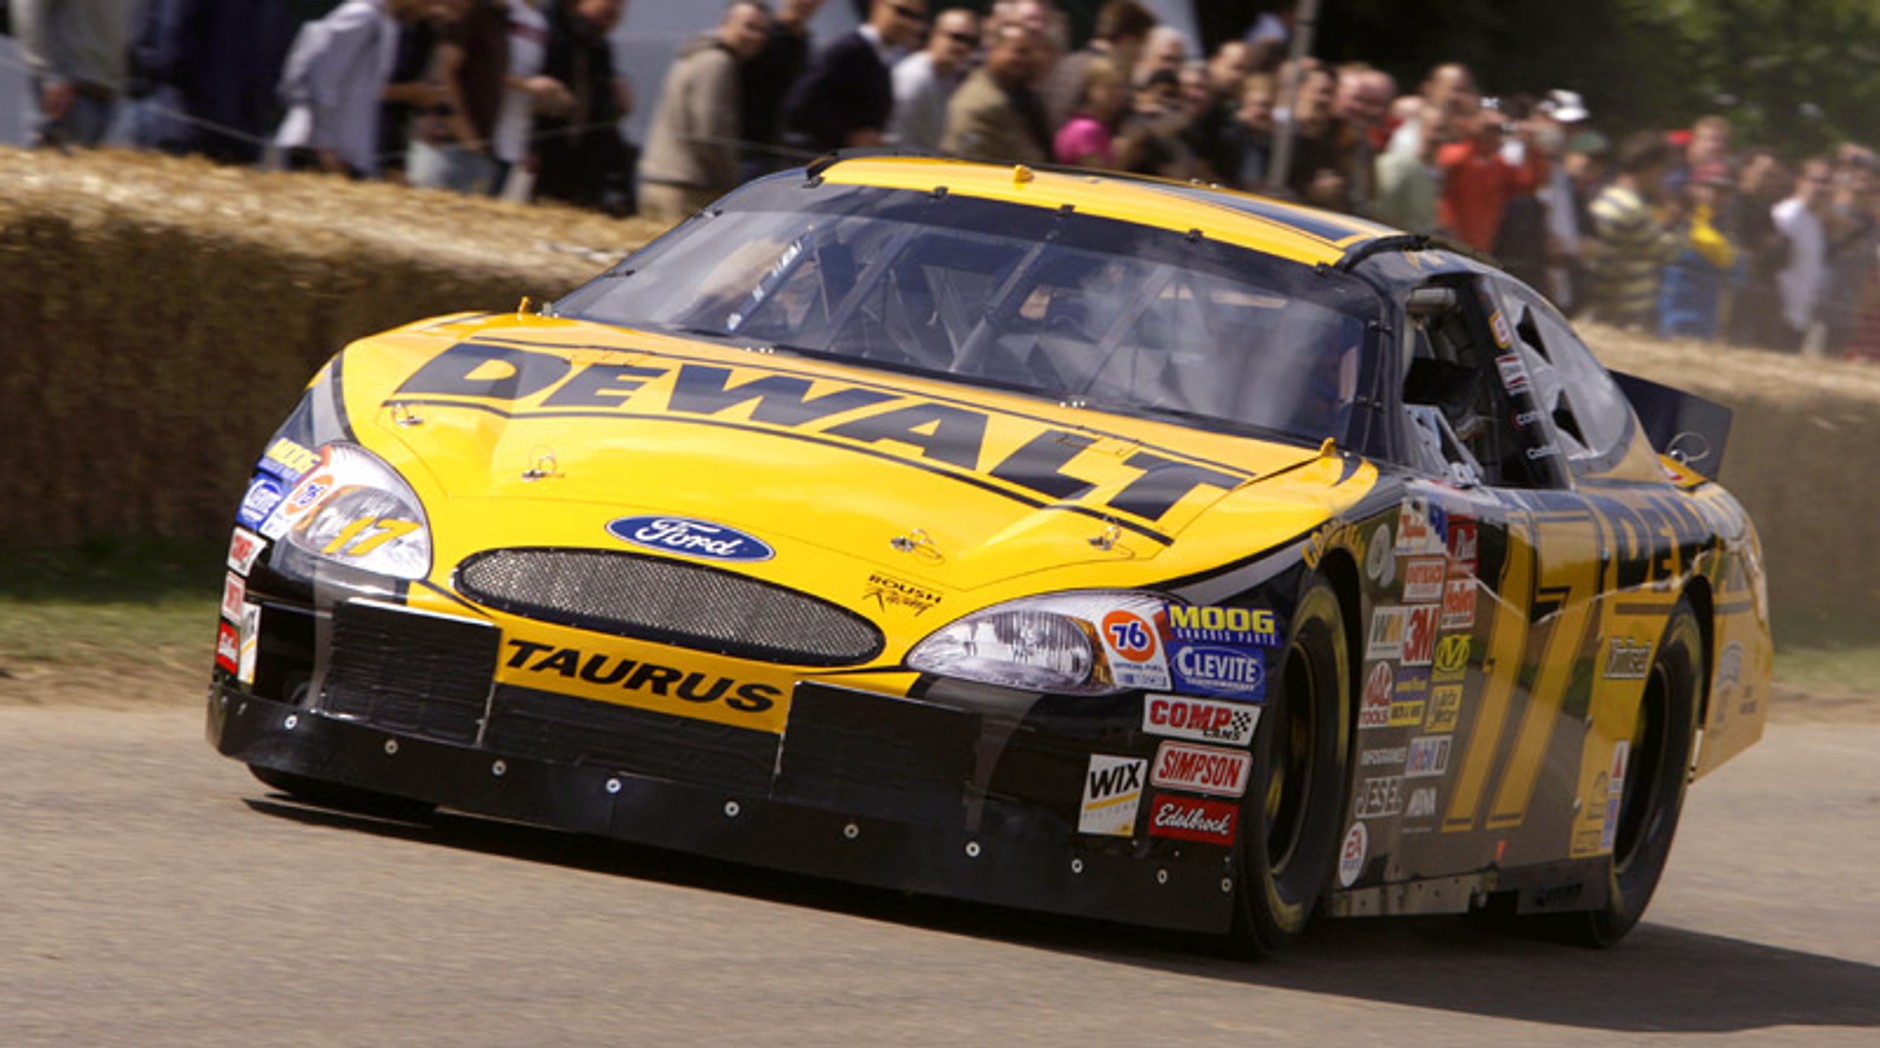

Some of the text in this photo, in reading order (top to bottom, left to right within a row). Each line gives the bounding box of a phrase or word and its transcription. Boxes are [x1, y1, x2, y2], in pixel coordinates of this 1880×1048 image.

[396, 341, 1250, 521] DEWALT
[320, 517, 422, 556] 17
[635, 518, 741, 558] Ford
[869, 574, 942, 604] ROUSH
[1111, 622, 1148, 650] 76
[1169, 605, 1275, 634] MOOG
[1403, 608, 1440, 663] 3M
[506, 639, 784, 714] TAURUS
[1177, 646, 1257, 683] CLEVITE
[1441, 512, 1599, 832] 17
[1150, 700, 1231, 731] COMP
[1203, 728, 1241, 742] CAMS
[1091, 761, 1142, 799] WIX
[1159, 750, 1243, 788] SIMPSON
[1154, 802, 1230, 836] Edelbrock
